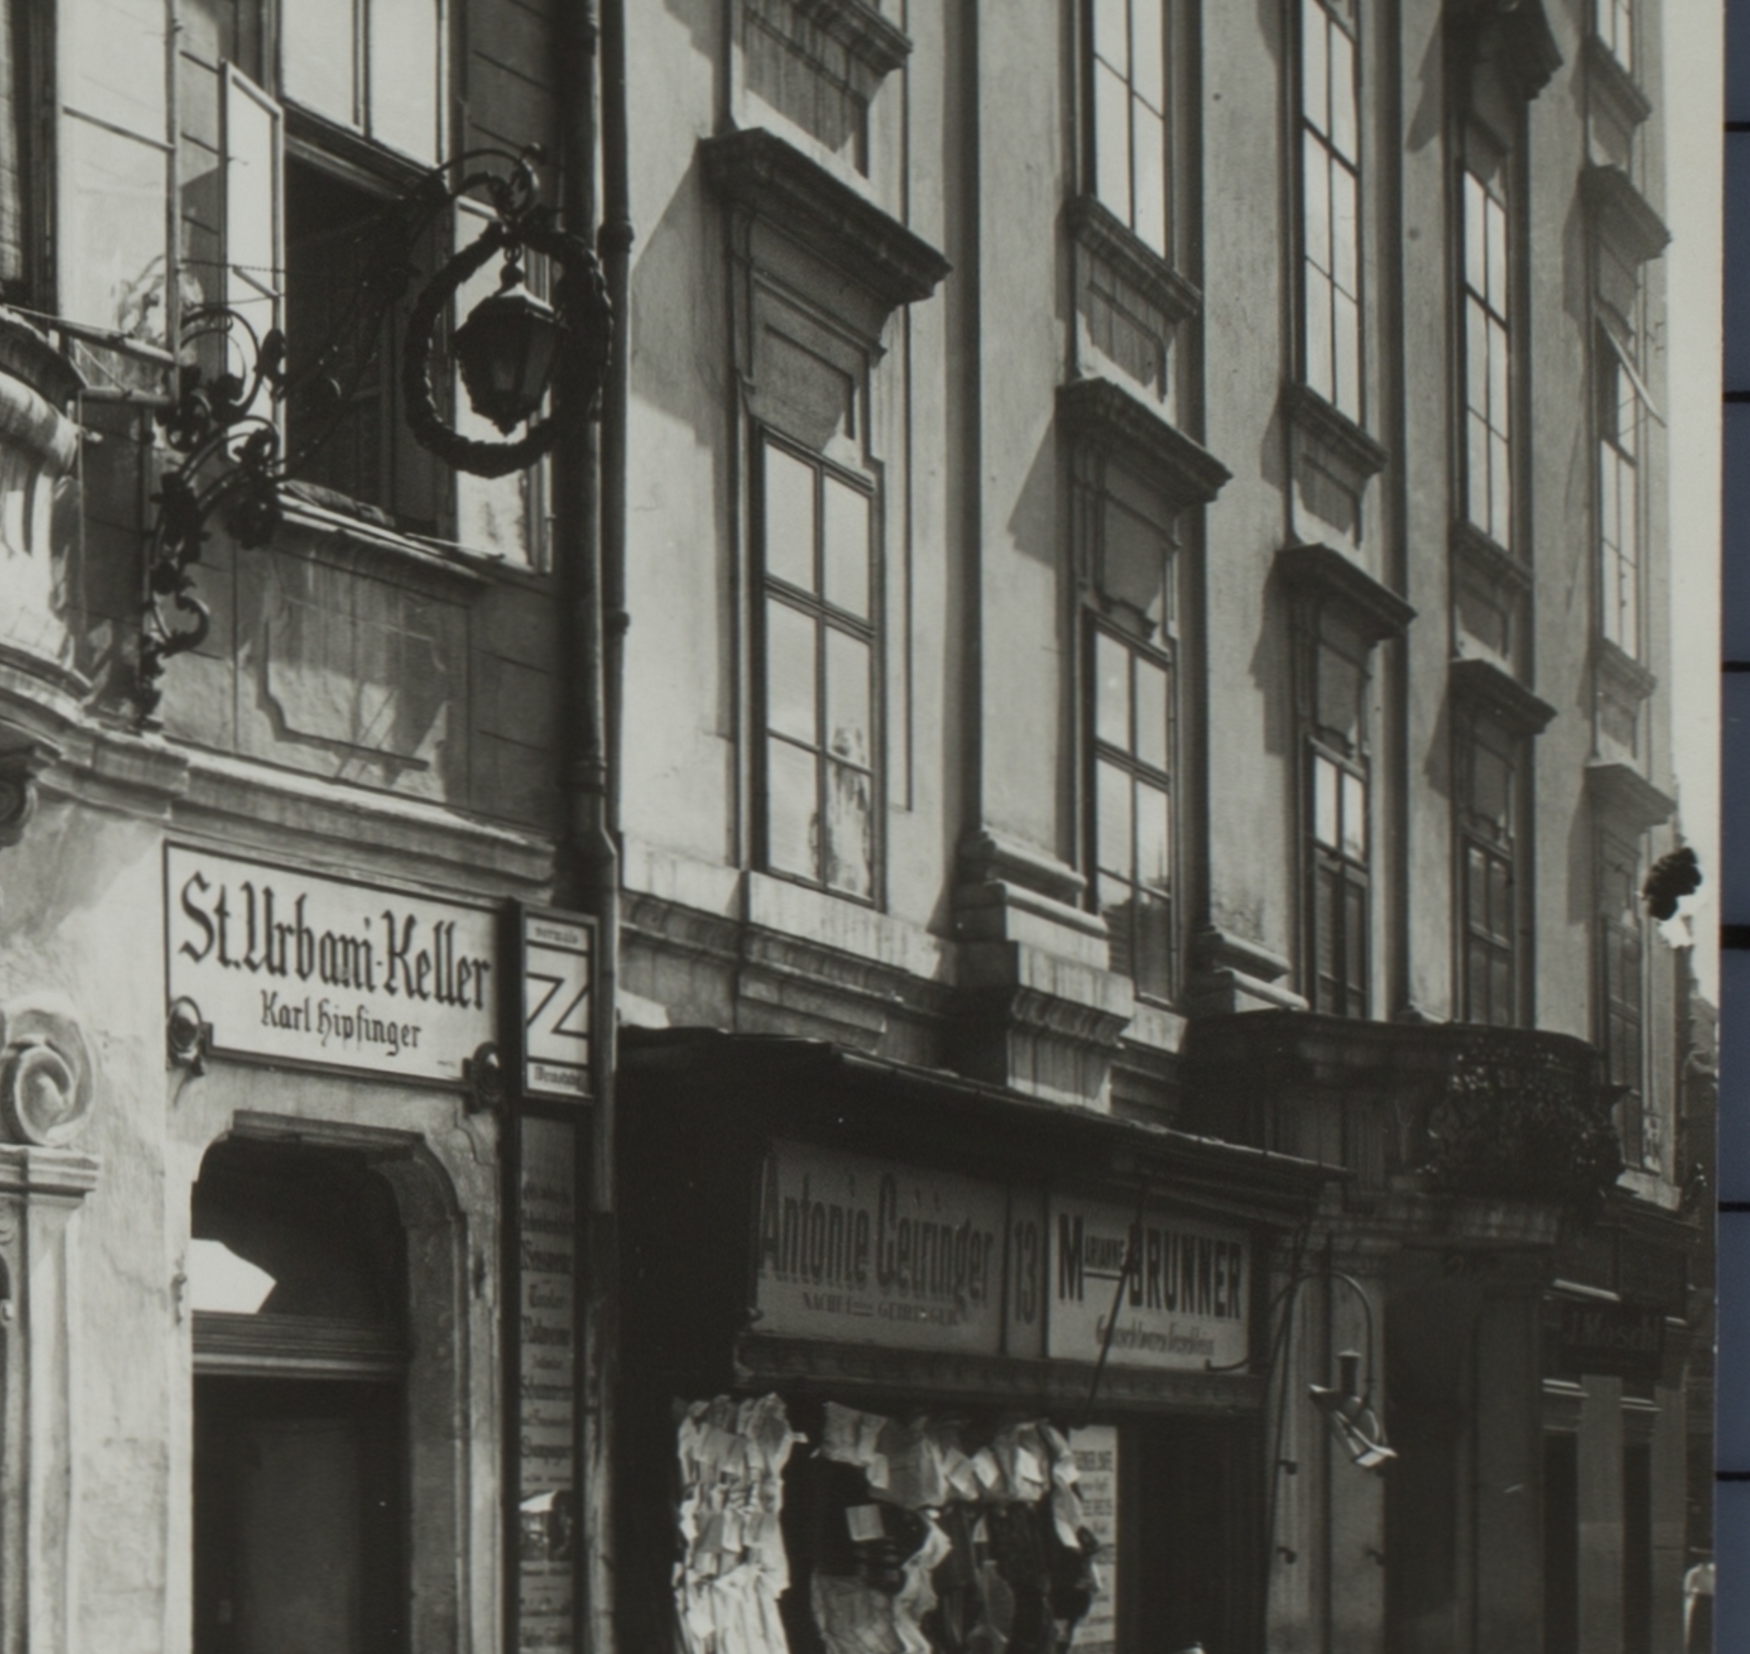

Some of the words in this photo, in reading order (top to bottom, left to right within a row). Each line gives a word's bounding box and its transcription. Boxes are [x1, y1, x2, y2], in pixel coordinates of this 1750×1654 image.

[260, 990, 311, 1034] Karl
[318, 998, 422, 1057] Hipfinger
[760, 1149, 870, 1285] Antonie
[1015, 1219, 1038, 1326] 13
[1129, 1224, 1242, 1320] BRUNNER
